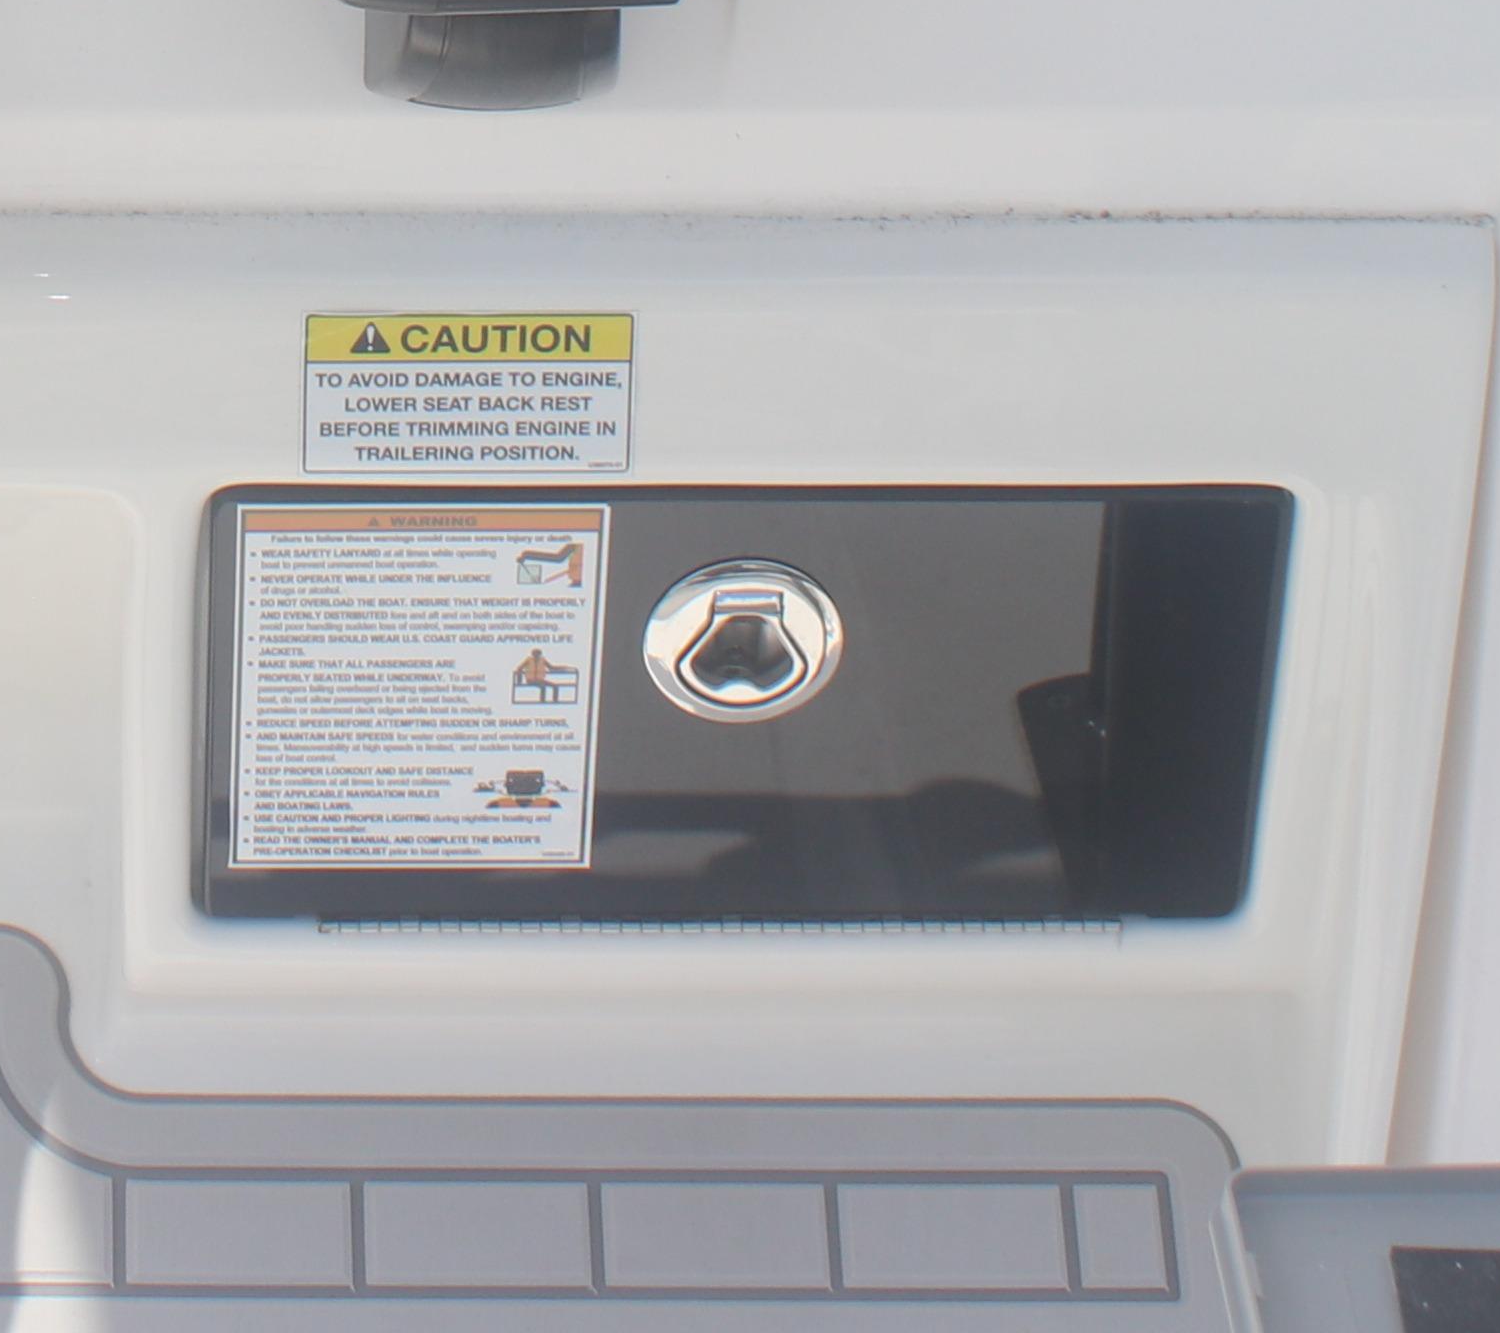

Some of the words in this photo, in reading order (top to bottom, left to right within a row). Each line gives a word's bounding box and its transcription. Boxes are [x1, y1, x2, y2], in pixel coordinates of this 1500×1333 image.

[401, 324, 591, 354] CAUTION
[315, 373, 342, 388] TO
[348, 373, 409, 387] AVOID
[415, 372, 502, 387] DAMAGE
[509, 372, 536, 387] TO
[542, 372, 622, 388] ENGINE,
[345, 397, 417, 412] LOWER
[423, 397, 472, 412] SEAT
[479, 396, 534, 411] BACK
[541, 396, 592, 411] REST
[320, 422, 399, 437] BEFORE
[406, 421, 509, 436] TRIMMING
[516, 421, 590, 436] ENGINE
[597, 421, 616, 435] IN
[355, 446, 474, 461] TRAILERING
[480, 446, 579, 460] POSITION.
[390, 516, 477, 526] WARNING
[261, 549, 291, 559] WEAR
[293, 549, 331, 559] SAFETY
[333, 549, 383, 559] LANYARD
[297, 575, 341, 583] OPERATE
[346, 575, 374, 583] WHILE
[379, 575, 412, 583] UNDER
